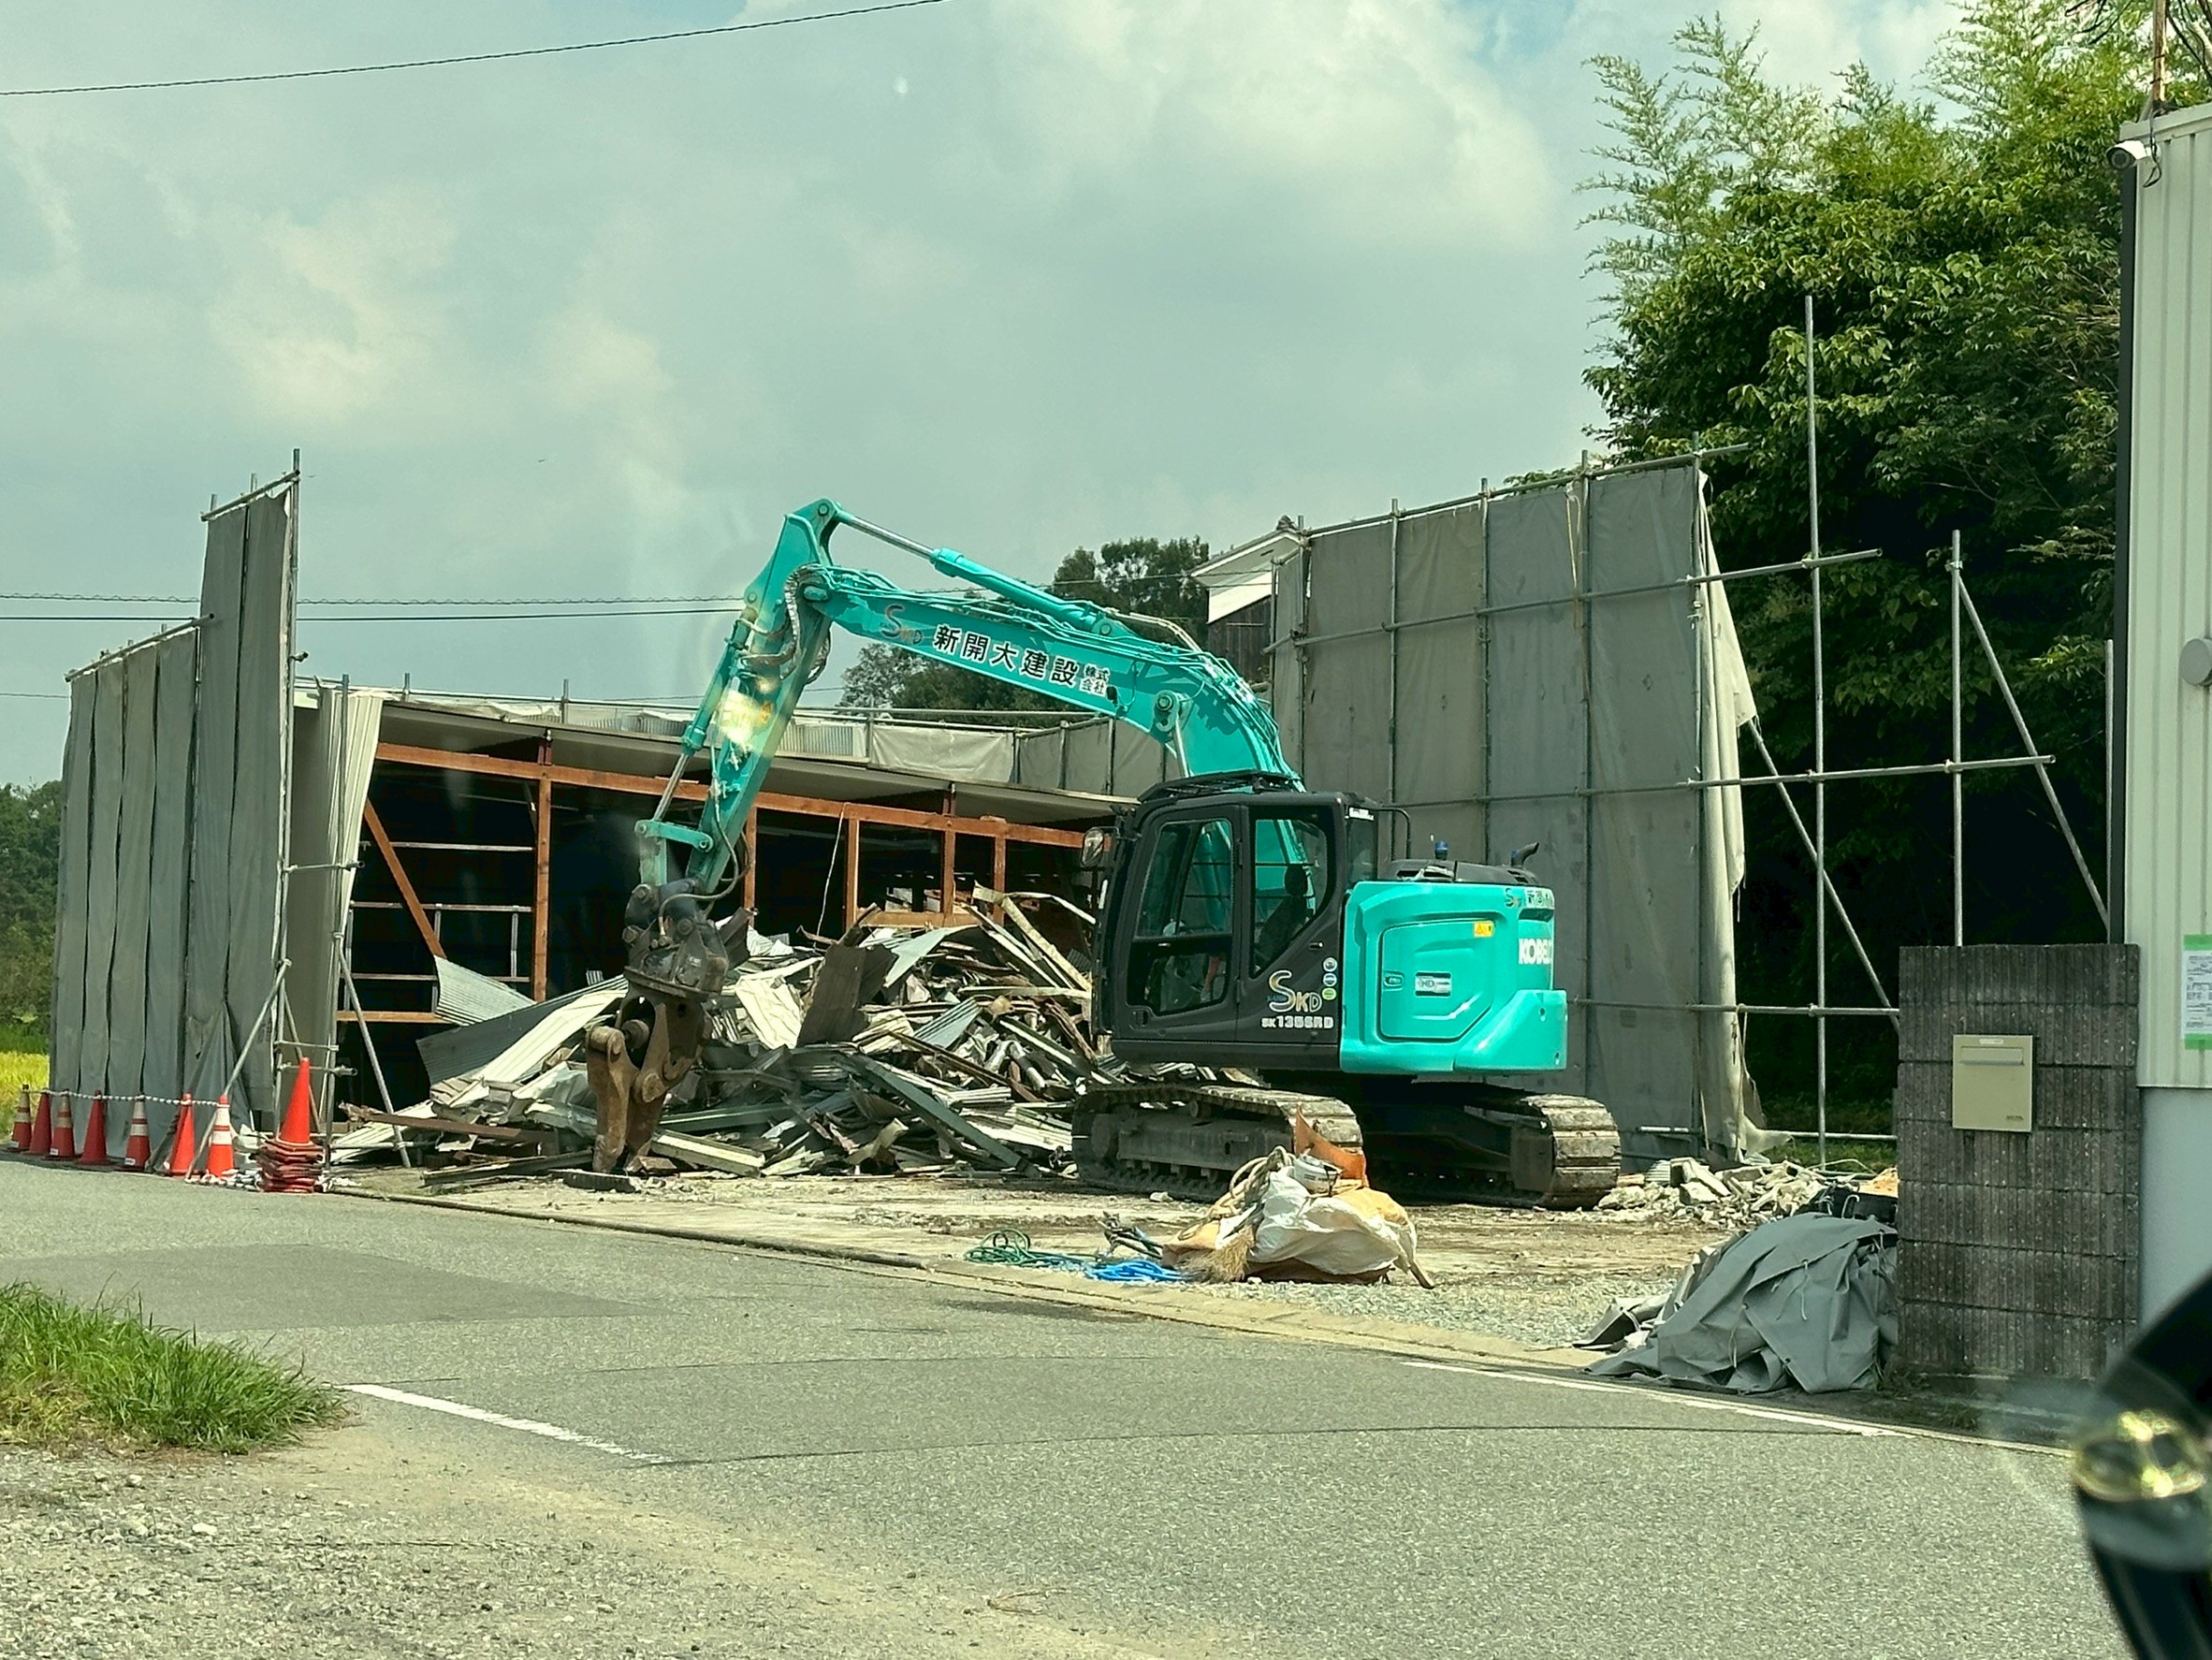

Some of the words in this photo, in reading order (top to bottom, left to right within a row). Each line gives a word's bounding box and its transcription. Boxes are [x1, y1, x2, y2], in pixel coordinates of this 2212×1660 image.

[933, 624, 1079, 687] 新開大建設
[1269, 969, 1322, 1012] SKD
